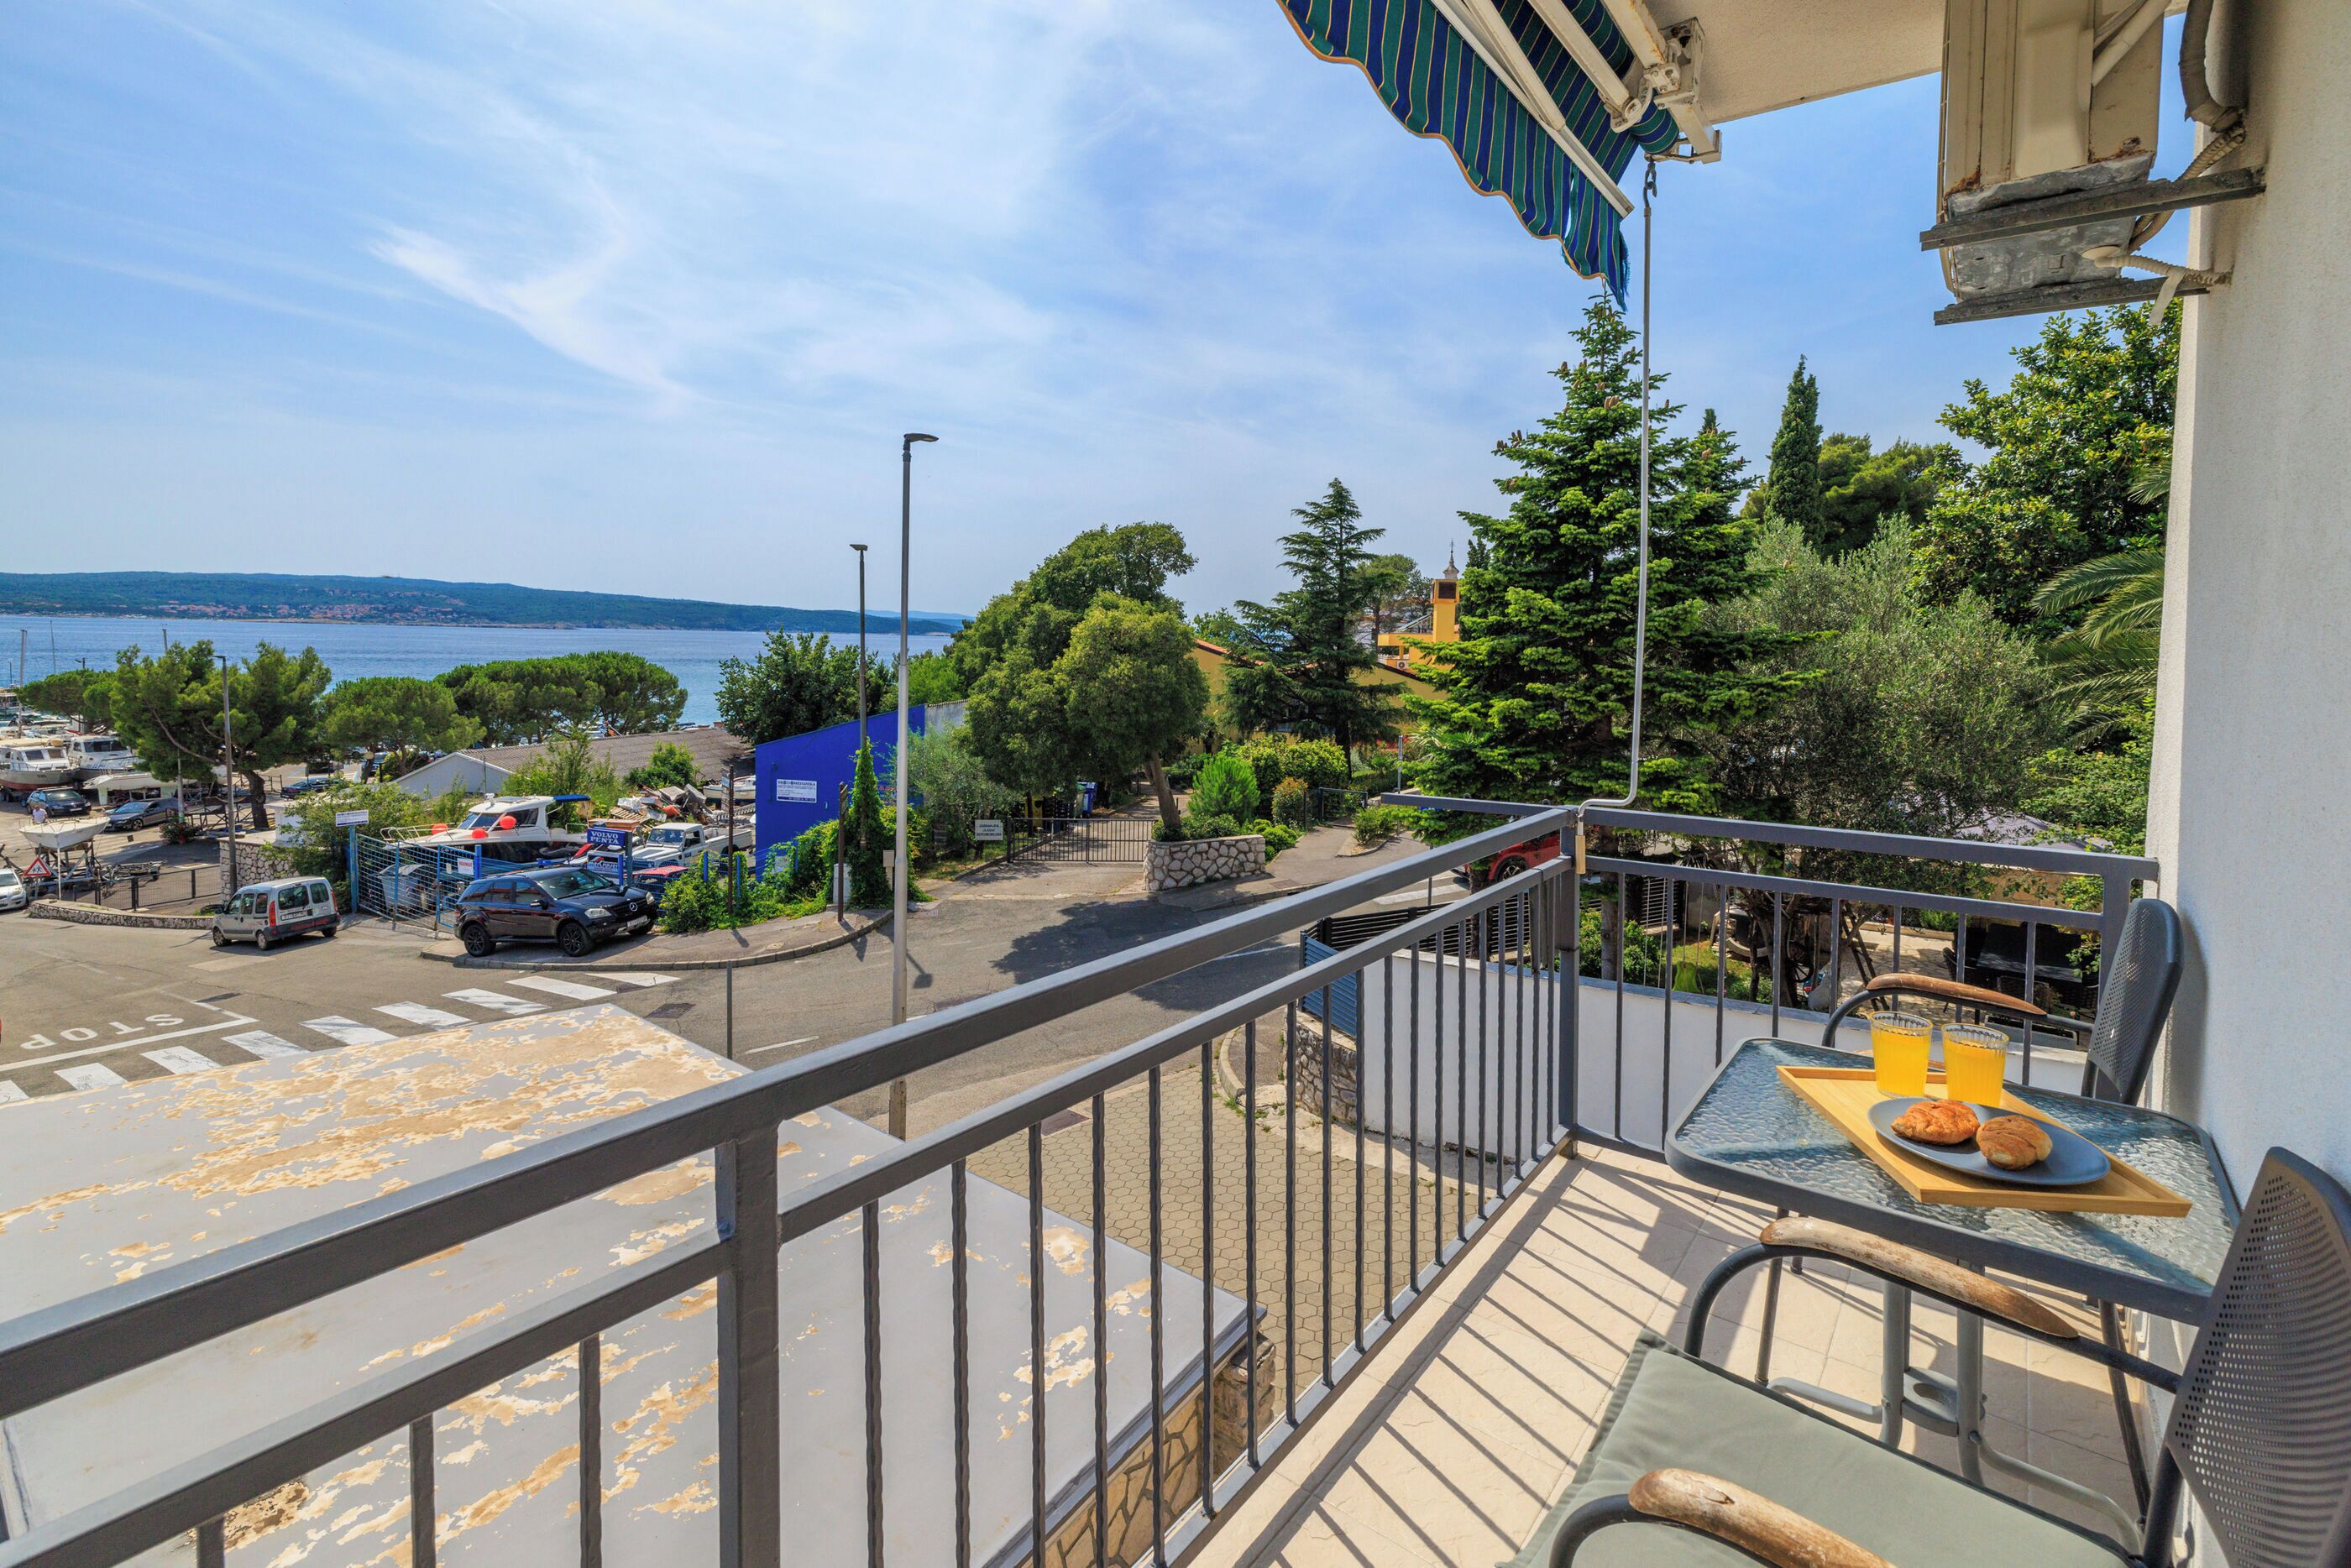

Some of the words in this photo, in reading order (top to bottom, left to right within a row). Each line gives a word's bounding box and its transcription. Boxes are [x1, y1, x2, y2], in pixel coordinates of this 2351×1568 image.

[591, 831, 619, 839] VOLVO
[590, 836, 619, 845] PENTA
[20, 1014, 184, 1049] STOP
